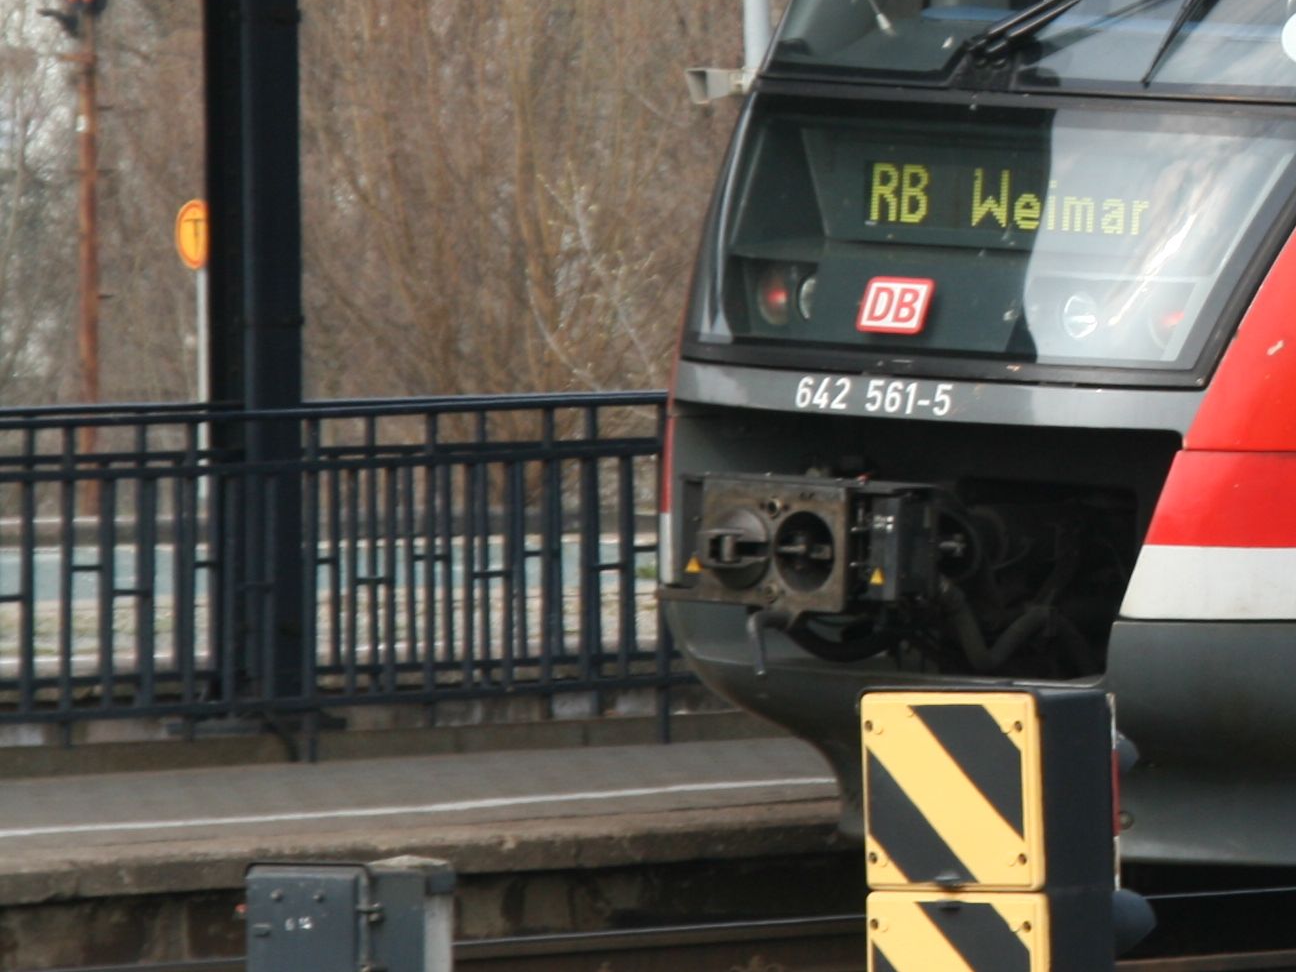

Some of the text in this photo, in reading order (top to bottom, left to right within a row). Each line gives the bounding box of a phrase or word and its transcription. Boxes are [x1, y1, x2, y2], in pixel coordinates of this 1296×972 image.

[868, 162, 1150, 237] RB Weimar
[863, 282, 922, 327] DB
[795, 376, 953, 417] 642 561-5
